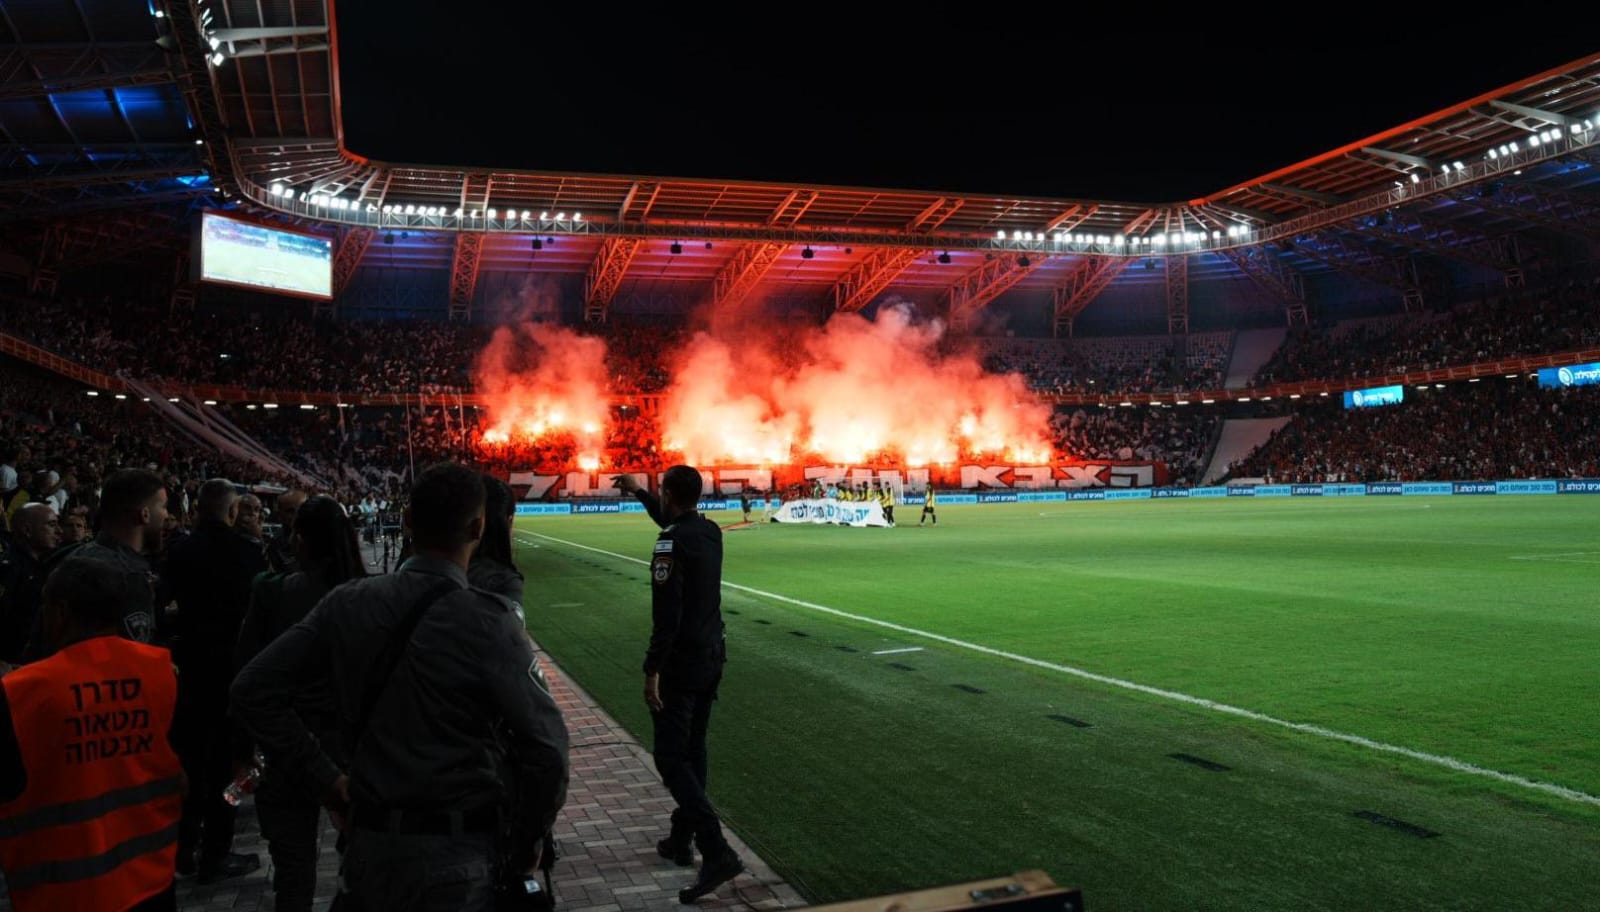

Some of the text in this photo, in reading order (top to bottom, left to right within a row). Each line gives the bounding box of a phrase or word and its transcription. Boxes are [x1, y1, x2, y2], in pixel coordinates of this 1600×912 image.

[960, 465, 1153, 489] הצבא
[69, 678, 141, 712] סדרן
[64, 709, 148, 737] מטאור
[64, 733, 154, 764] אבטחה
